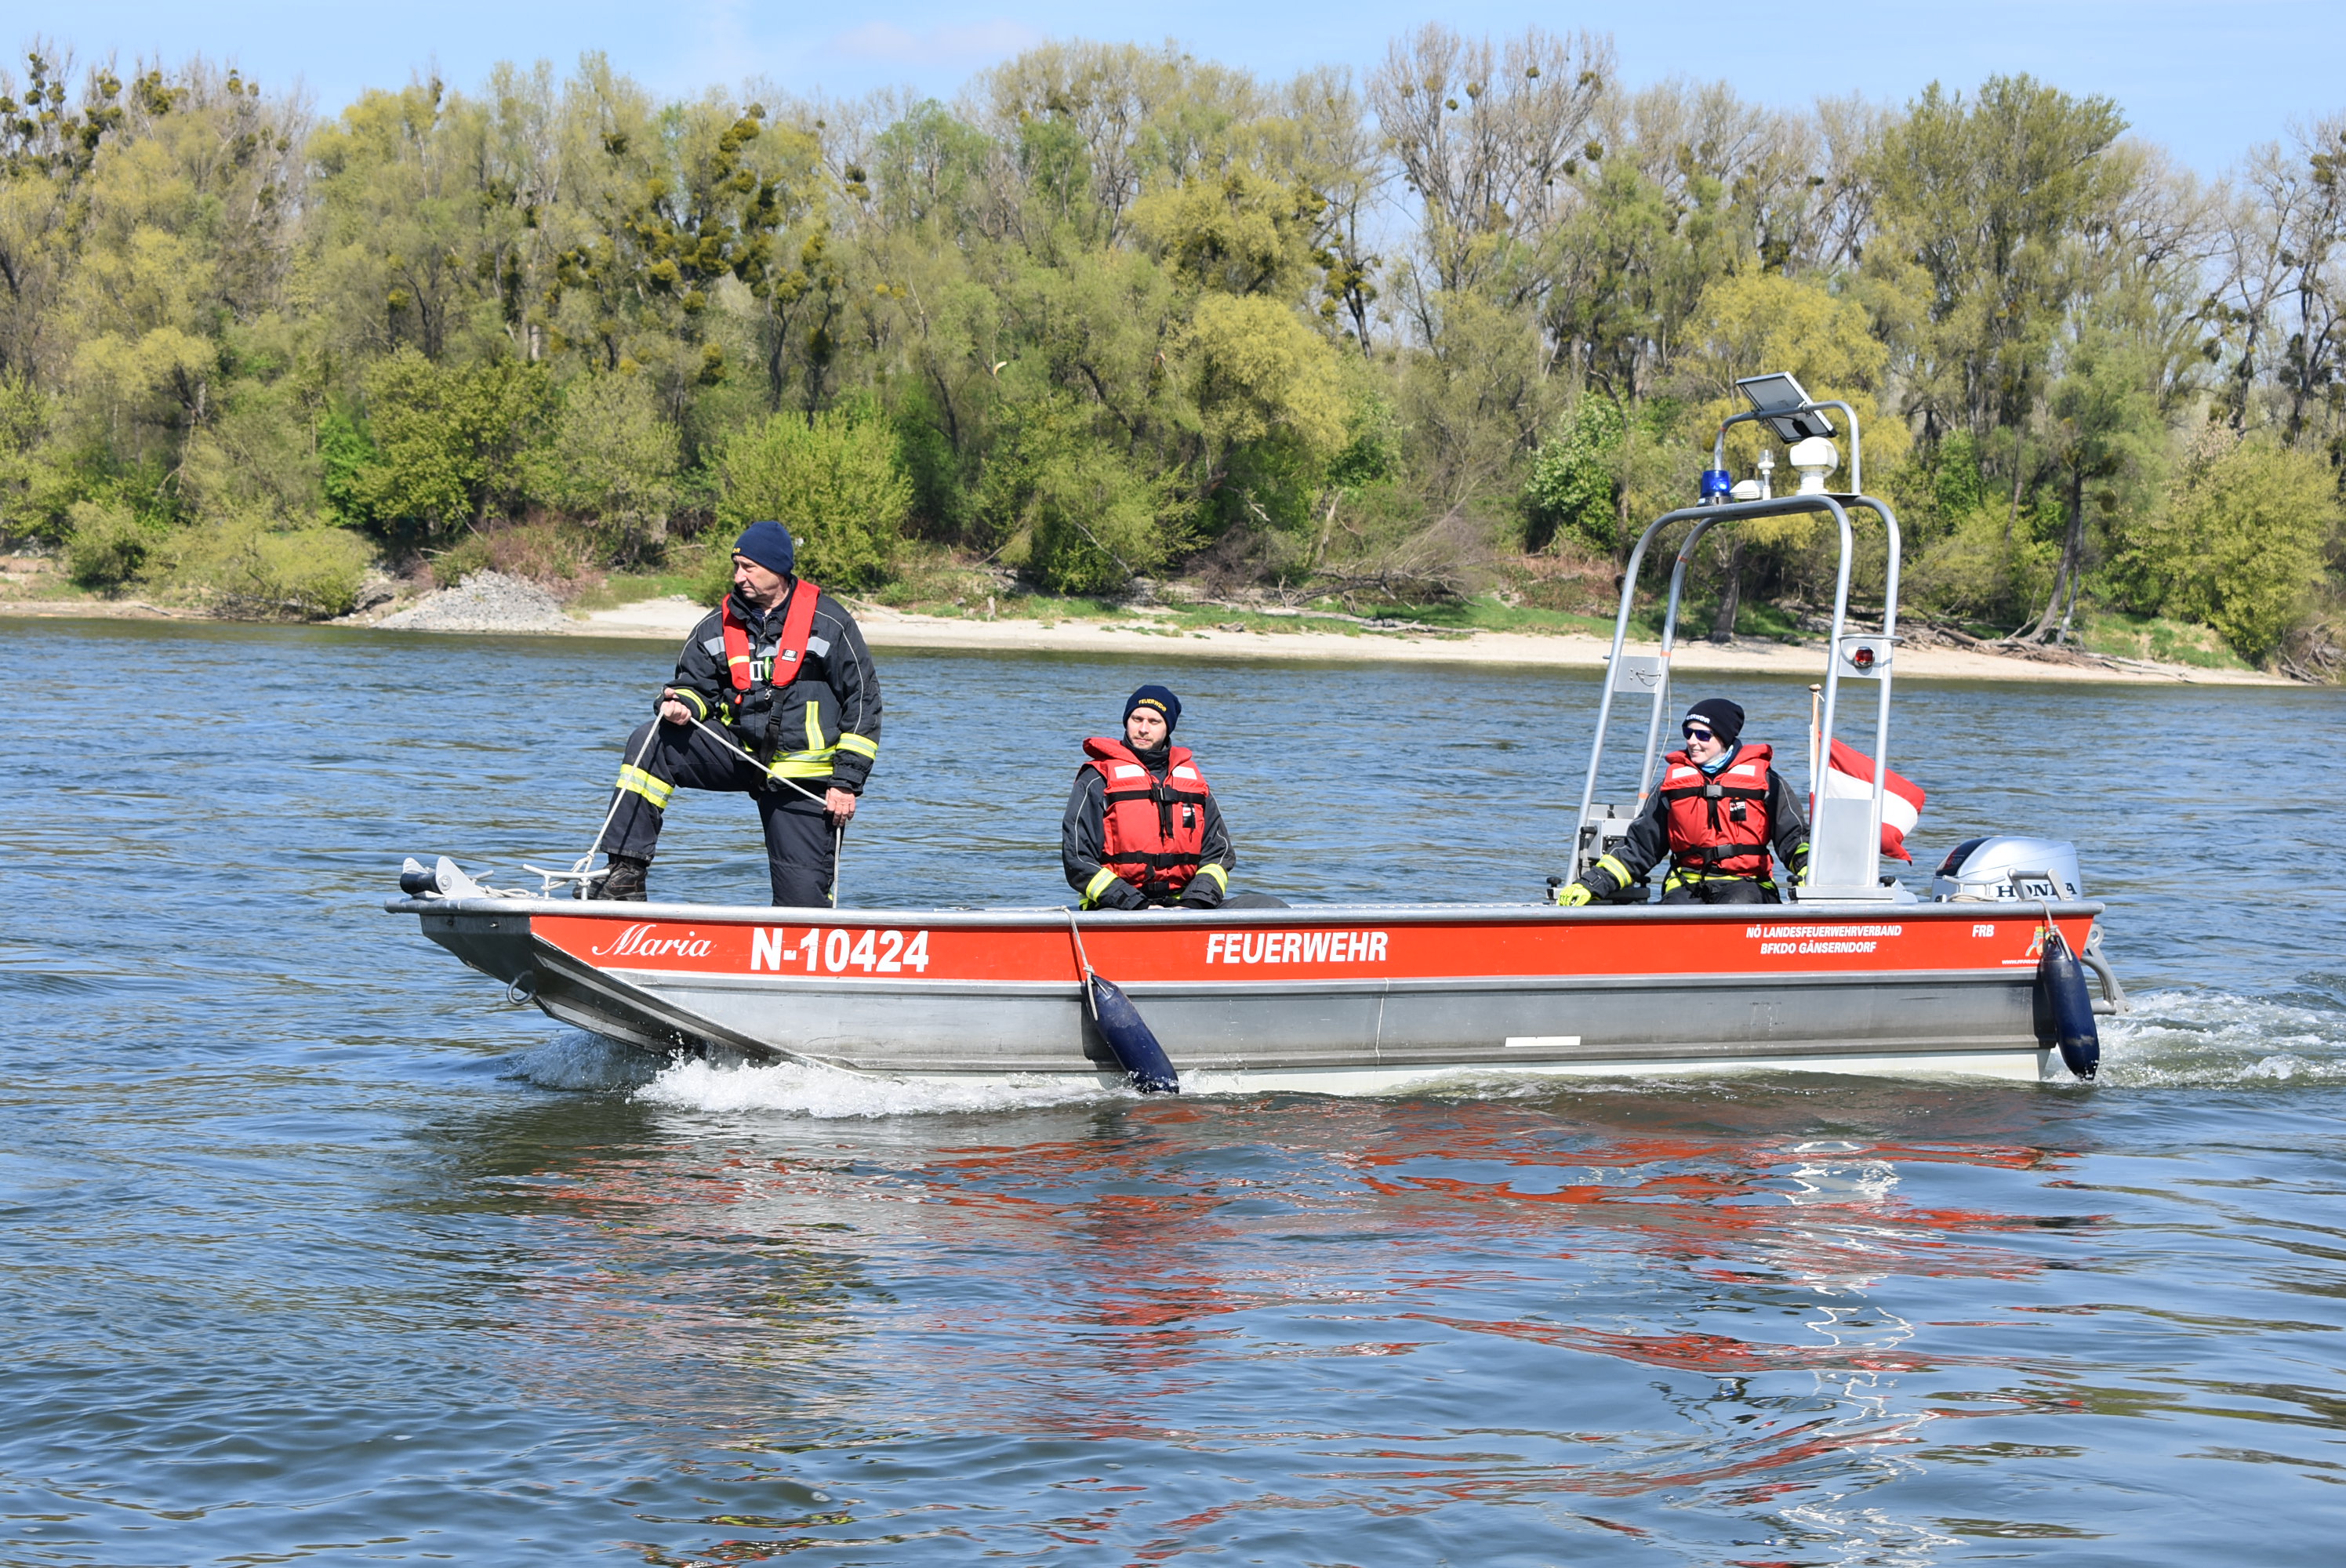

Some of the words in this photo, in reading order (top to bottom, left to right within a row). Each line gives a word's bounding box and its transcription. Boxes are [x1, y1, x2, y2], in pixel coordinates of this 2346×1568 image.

[592, 924, 717, 957] Maria
[1745, 924, 1762, 938] NÖ
[1763, 925, 1902, 938] LANDESFEUERWEHRVERBAND
[1971, 924, 1995, 938] FRB
[750, 927, 929, 972] N-10424
[1205, 931, 1389, 964] FEUERWEHR
[1760, 942, 1796, 955] BFKDO
[1799, 939, 1877, 954] GÄNSERNDORF
